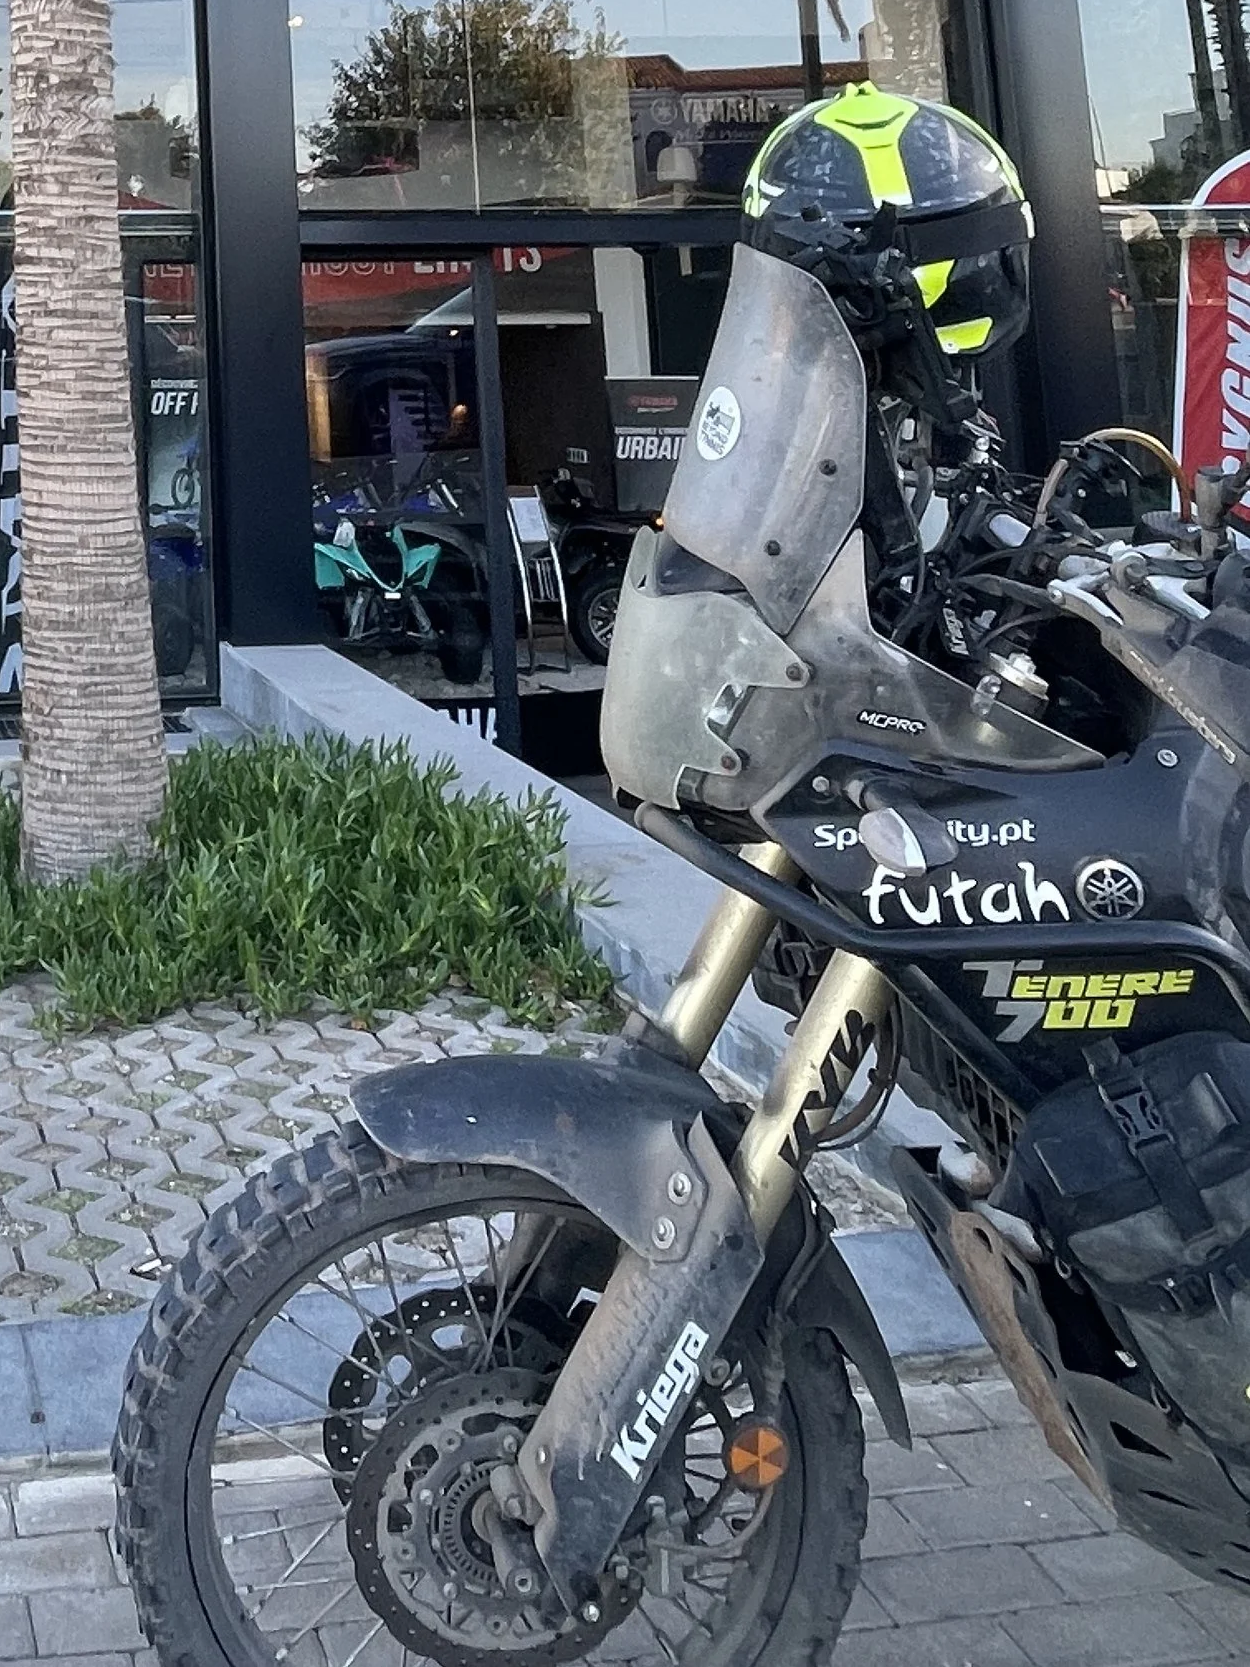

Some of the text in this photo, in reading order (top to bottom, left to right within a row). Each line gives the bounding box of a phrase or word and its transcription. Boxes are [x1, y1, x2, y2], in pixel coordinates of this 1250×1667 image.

[150, 390, 189, 416] OFF
[861, 861, 1072, 926] futah
[995, 998, 1137, 1044] 700
[609, 1320, 710, 1483] Kriega
